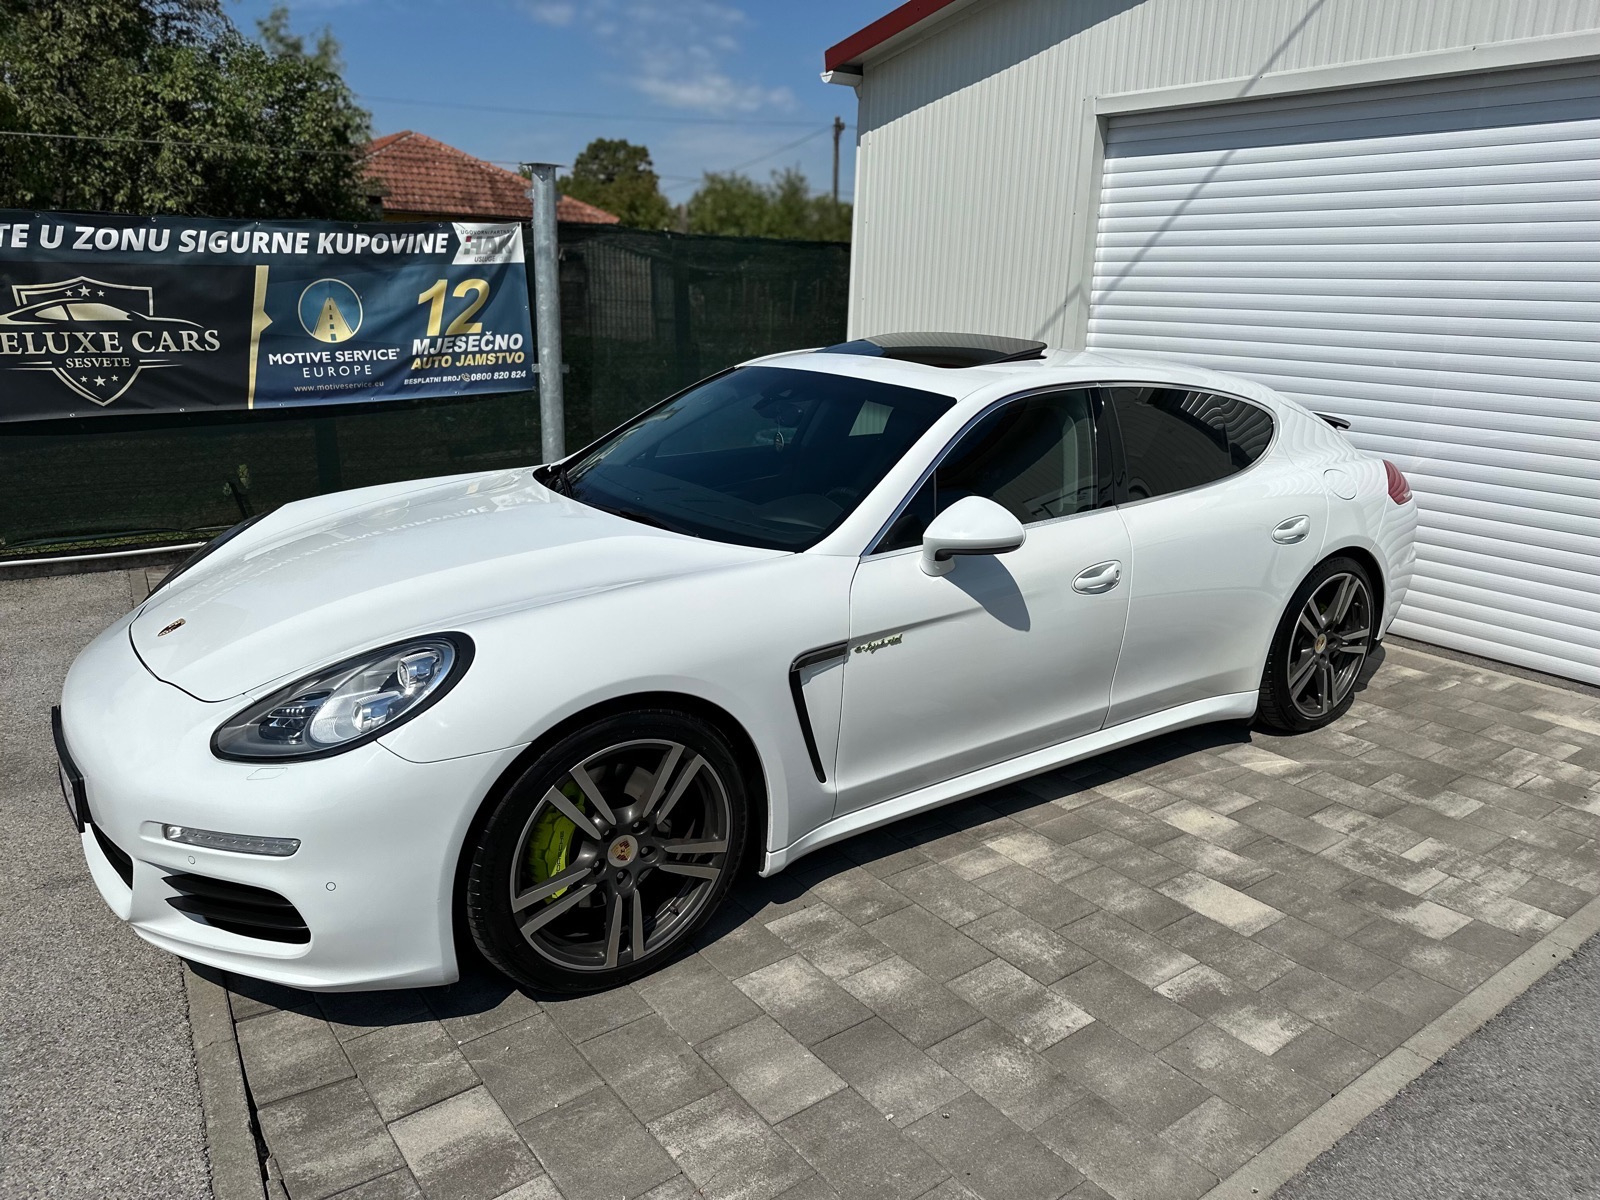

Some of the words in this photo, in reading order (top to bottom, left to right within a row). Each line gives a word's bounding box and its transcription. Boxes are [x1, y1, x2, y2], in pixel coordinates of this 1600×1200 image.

[40, 225, 64, 249] U
[73, 226, 170, 251] ZONU
[178, 229, 310, 254] SIGURNE
[317, 232, 449, 254] KUPOVINE
[418, 279, 490, 336] 12
[131, 329, 221, 353] CARS
[411, 331, 524, 355] MJESEČNO
[66, 357, 131, 369] SESVETE
[268, 351, 331, 365] MOTIVE
[411, 356, 452, 370] AUTO
[455, 351, 525, 367] JAMSTVO
[302, 364, 372, 378] EUROPE
[404, 376, 441, 385] BESPLATNI
[442, 375, 461, 383] BROJ
[470, 372, 492, 381] 0800
[493, 371, 509, 380] 820
[510, 370, 527, 379] 824
[293, 381, 384, 392] www.motiveservice.eu
